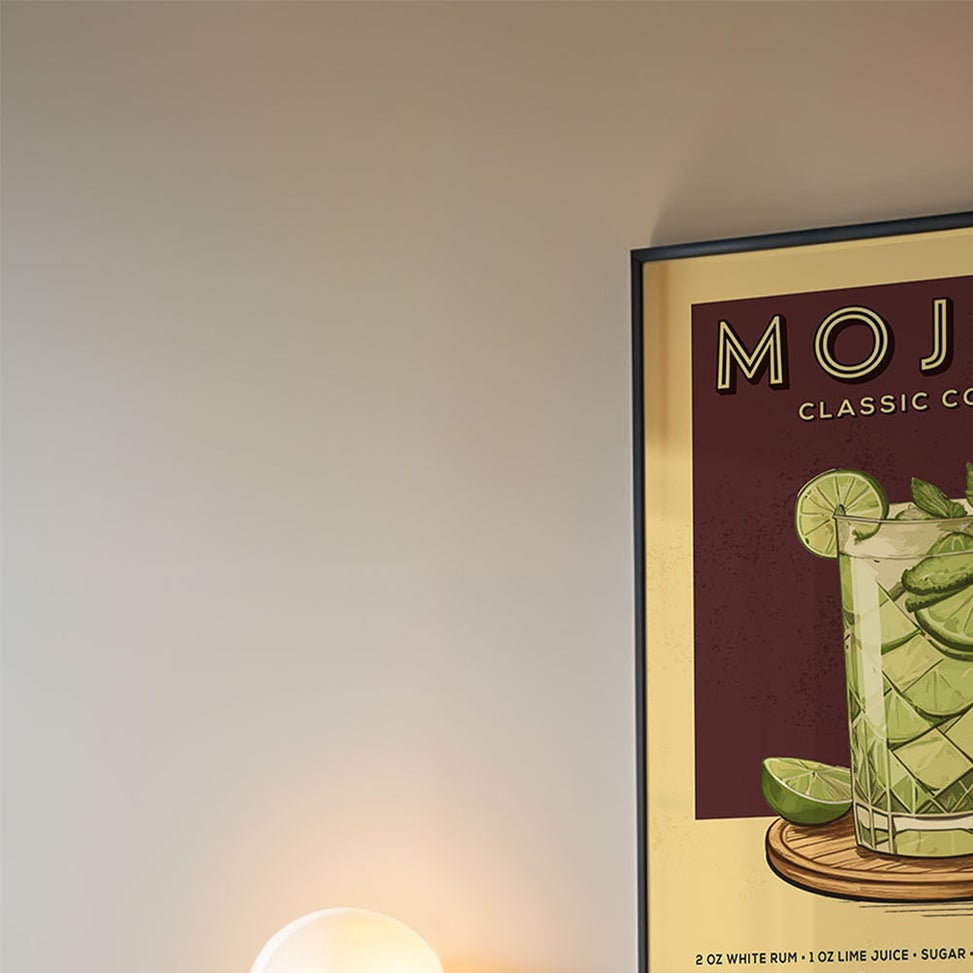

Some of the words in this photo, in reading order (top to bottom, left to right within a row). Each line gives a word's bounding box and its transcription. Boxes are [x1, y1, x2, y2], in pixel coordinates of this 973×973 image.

[798, 392, 929, 422] CLASSIC
[695, 953, 704, 966] 2
[706, 953, 723, 966] OZ
[726, 952, 767, 966] WHITE
[770, 952, 798, 966] RUM
[809, 952, 815, 964] 1
[818, 951, 834, 963] OZ
[838, 950, 868, 963] LIME
[870, 949, 910, 962] JUICE
[920, 947, 967, 961] SUGAR
